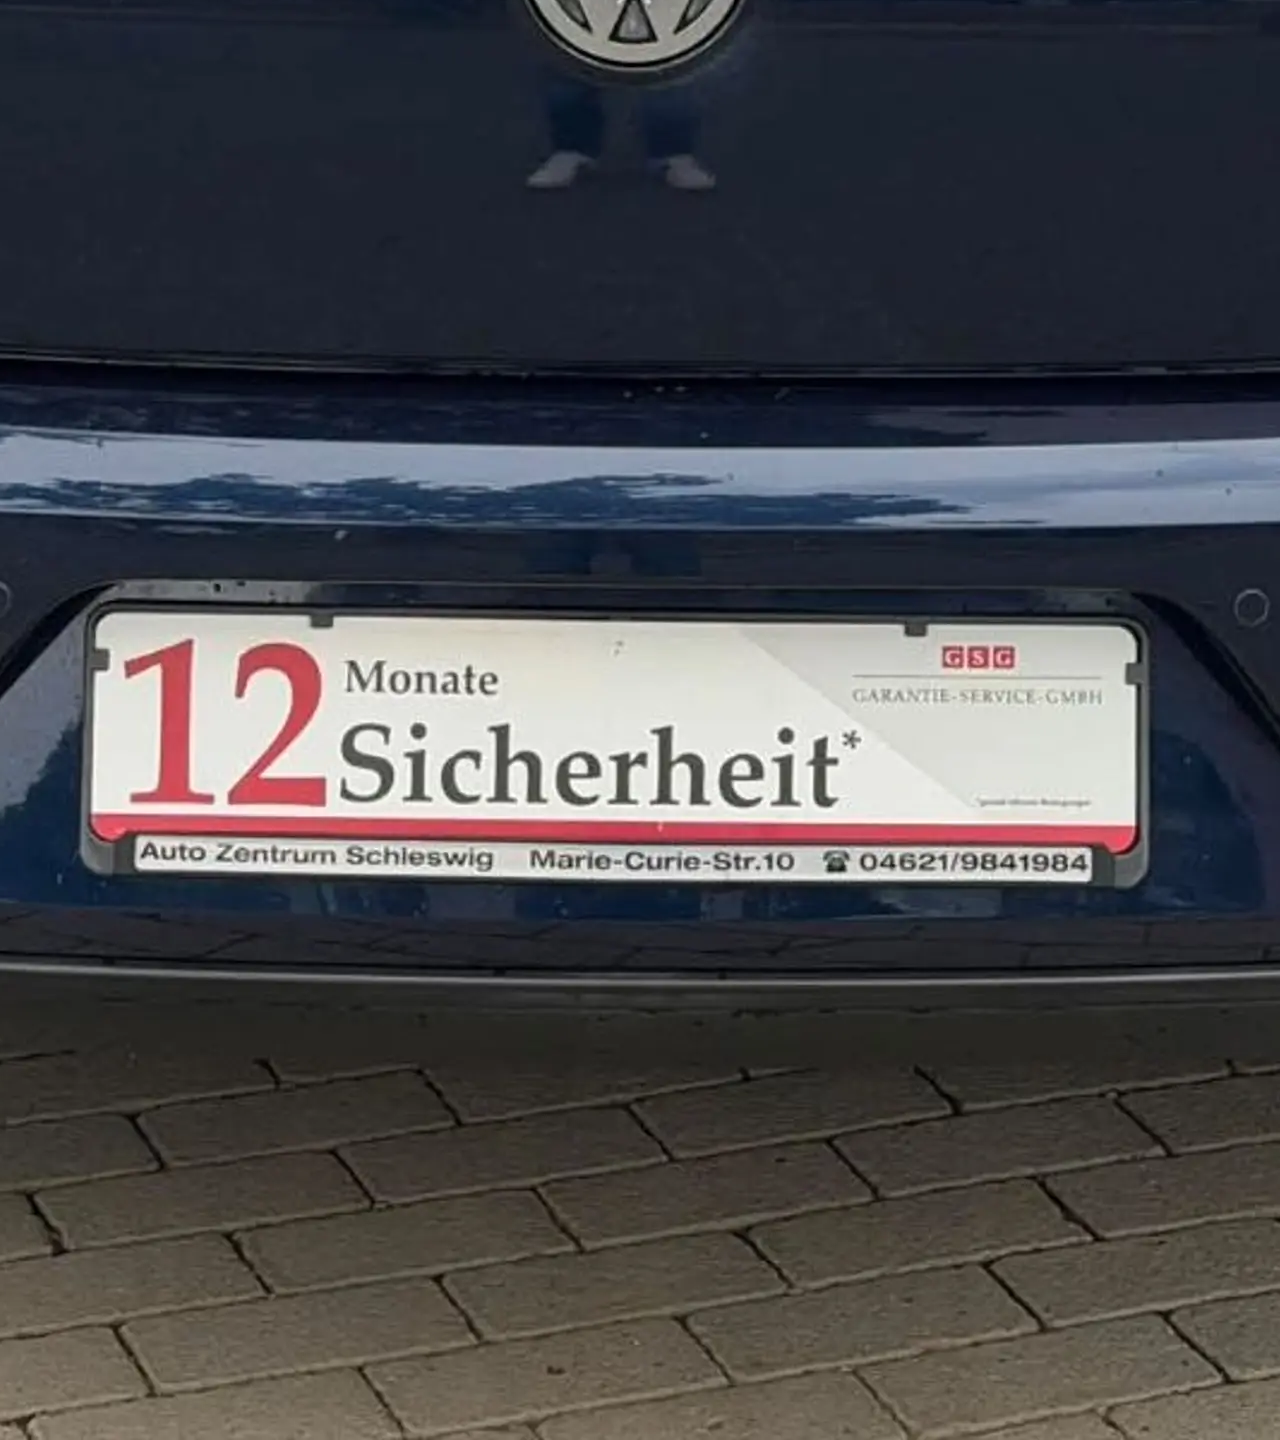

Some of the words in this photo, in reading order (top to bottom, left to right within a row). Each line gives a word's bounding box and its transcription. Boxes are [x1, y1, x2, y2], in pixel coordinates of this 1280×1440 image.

[943, 647, 1014, 668] GSG
[124, 638, 327, 807] 12
[345, 659, 498, 696] Monate
[140, 842, 206, 861] Auto
[215, 844, 337, 864] Zentrum
[346, 846, 494, 872] Schleswig
[530, 849, 795, 871] Marie-Curie-Str.10
[859, 850, 1090, 874] 04621/9841984
